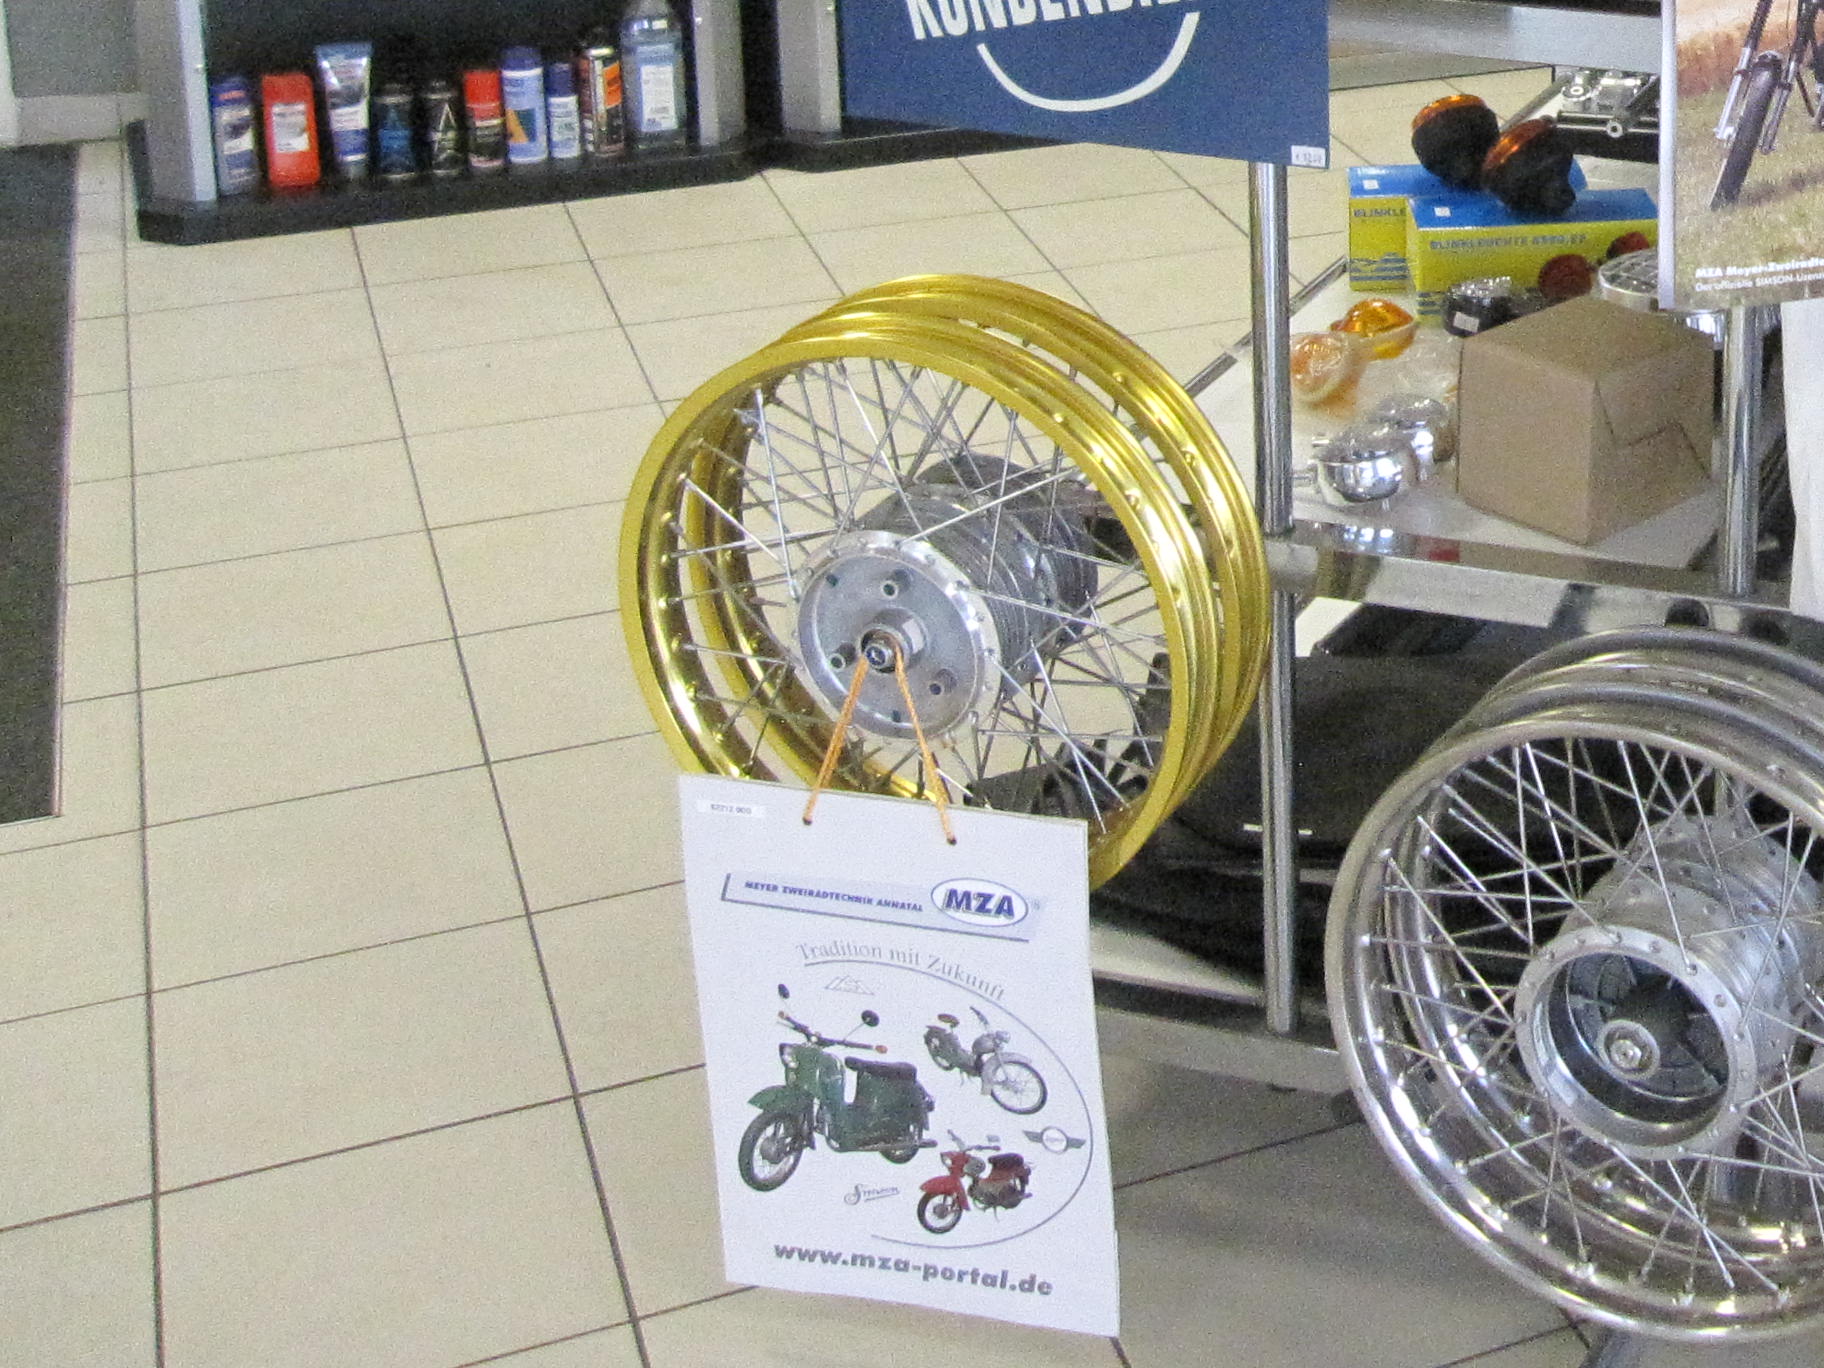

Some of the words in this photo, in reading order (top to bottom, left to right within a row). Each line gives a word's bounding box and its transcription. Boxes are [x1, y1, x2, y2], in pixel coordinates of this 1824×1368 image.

[1353, 207, 1407, 218] BLINKLE
[1695, 267, 1724, 279] MZA
[744, 880, 779, 893] MEYER
[943, 888, 1016, 920] MZA
[795, 939, 883, 962] Tradition
[889, 947, 921, 966] mit
[927, 953, 1006, 1002] Zukunft
[773, 1243, 1054, 1297] www.mza-portal.de
